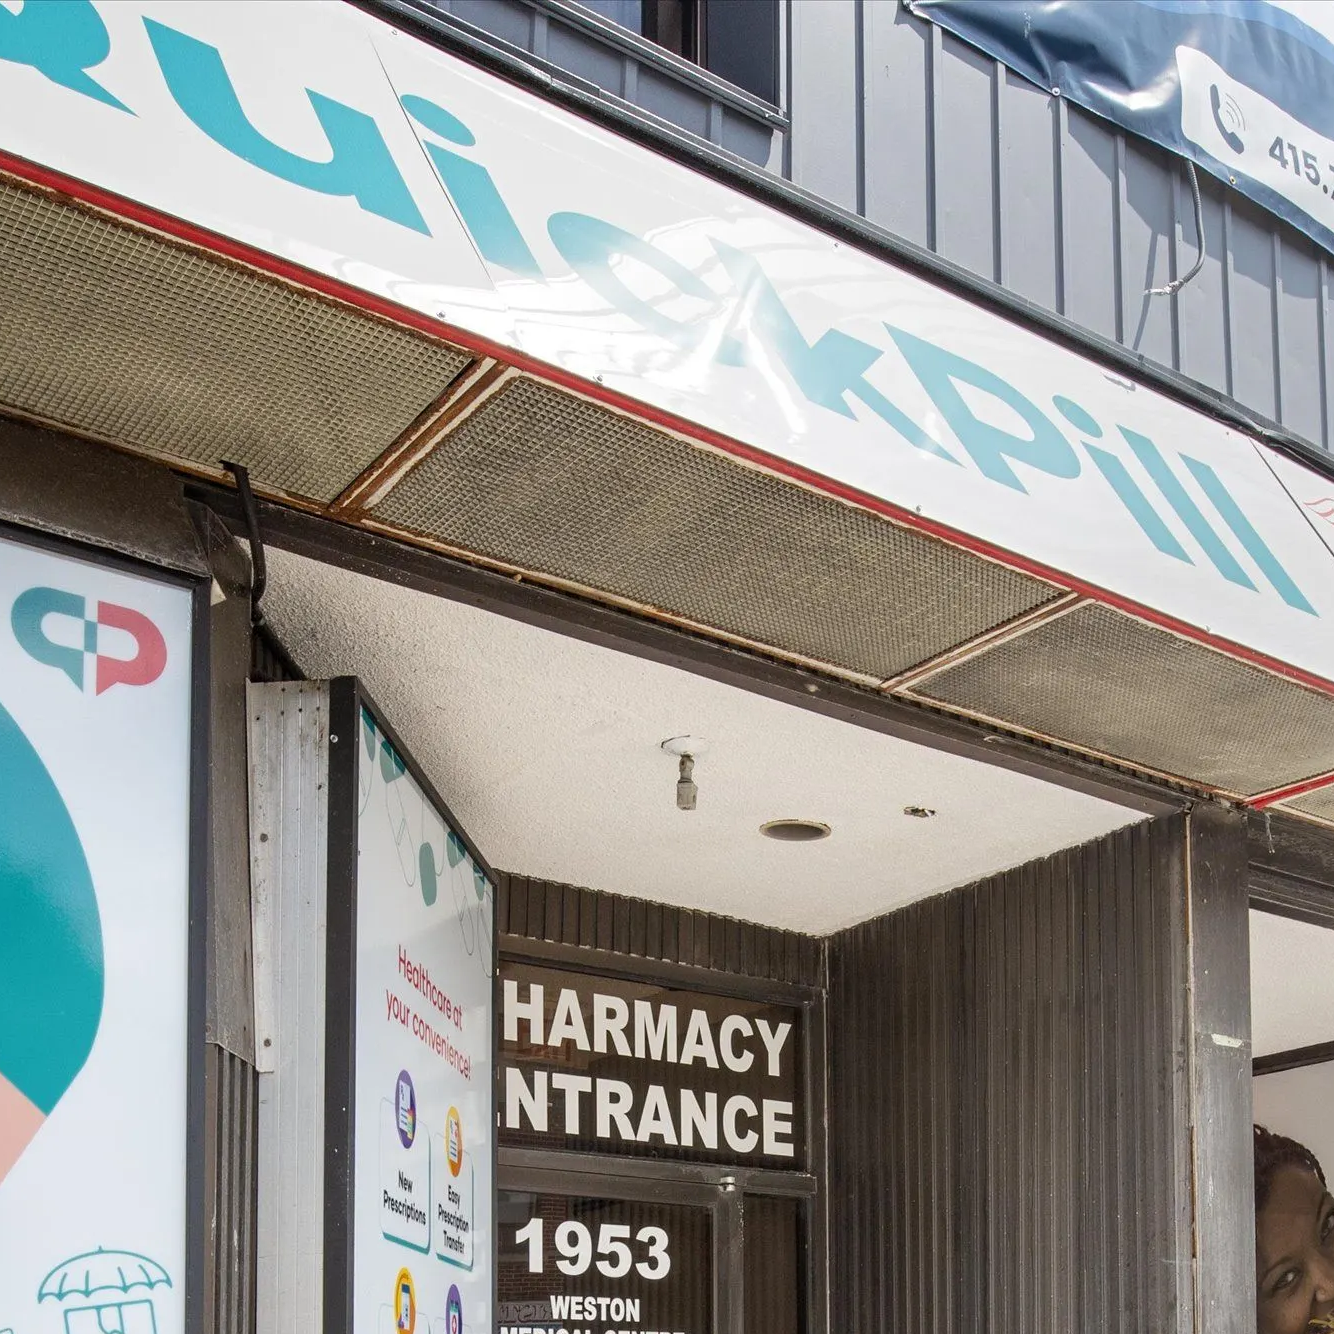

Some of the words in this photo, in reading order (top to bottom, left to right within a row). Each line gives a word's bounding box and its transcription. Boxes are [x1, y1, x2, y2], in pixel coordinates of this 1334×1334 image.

[397, 943, 452, 1021] Healthcare
[453, 1001, 463, 1032] at
[385, 989, 410, 1029] your
[412, 1009, 472, 1081] convenience!
[503, 979, 792, 1077] HARMACY
[505, 1067, 794, 1158] NTRANCE
[398, 1169, 413, 1194] New
[447, 1184, 461, 1210] Easy
[382, 1188, 427, 1227] Prescriptions
[438, 1201, 469, 1234] Prescription
[515, 1217, 671, 1280] 1953
[550, 1295, 640, 1322] WESTON
